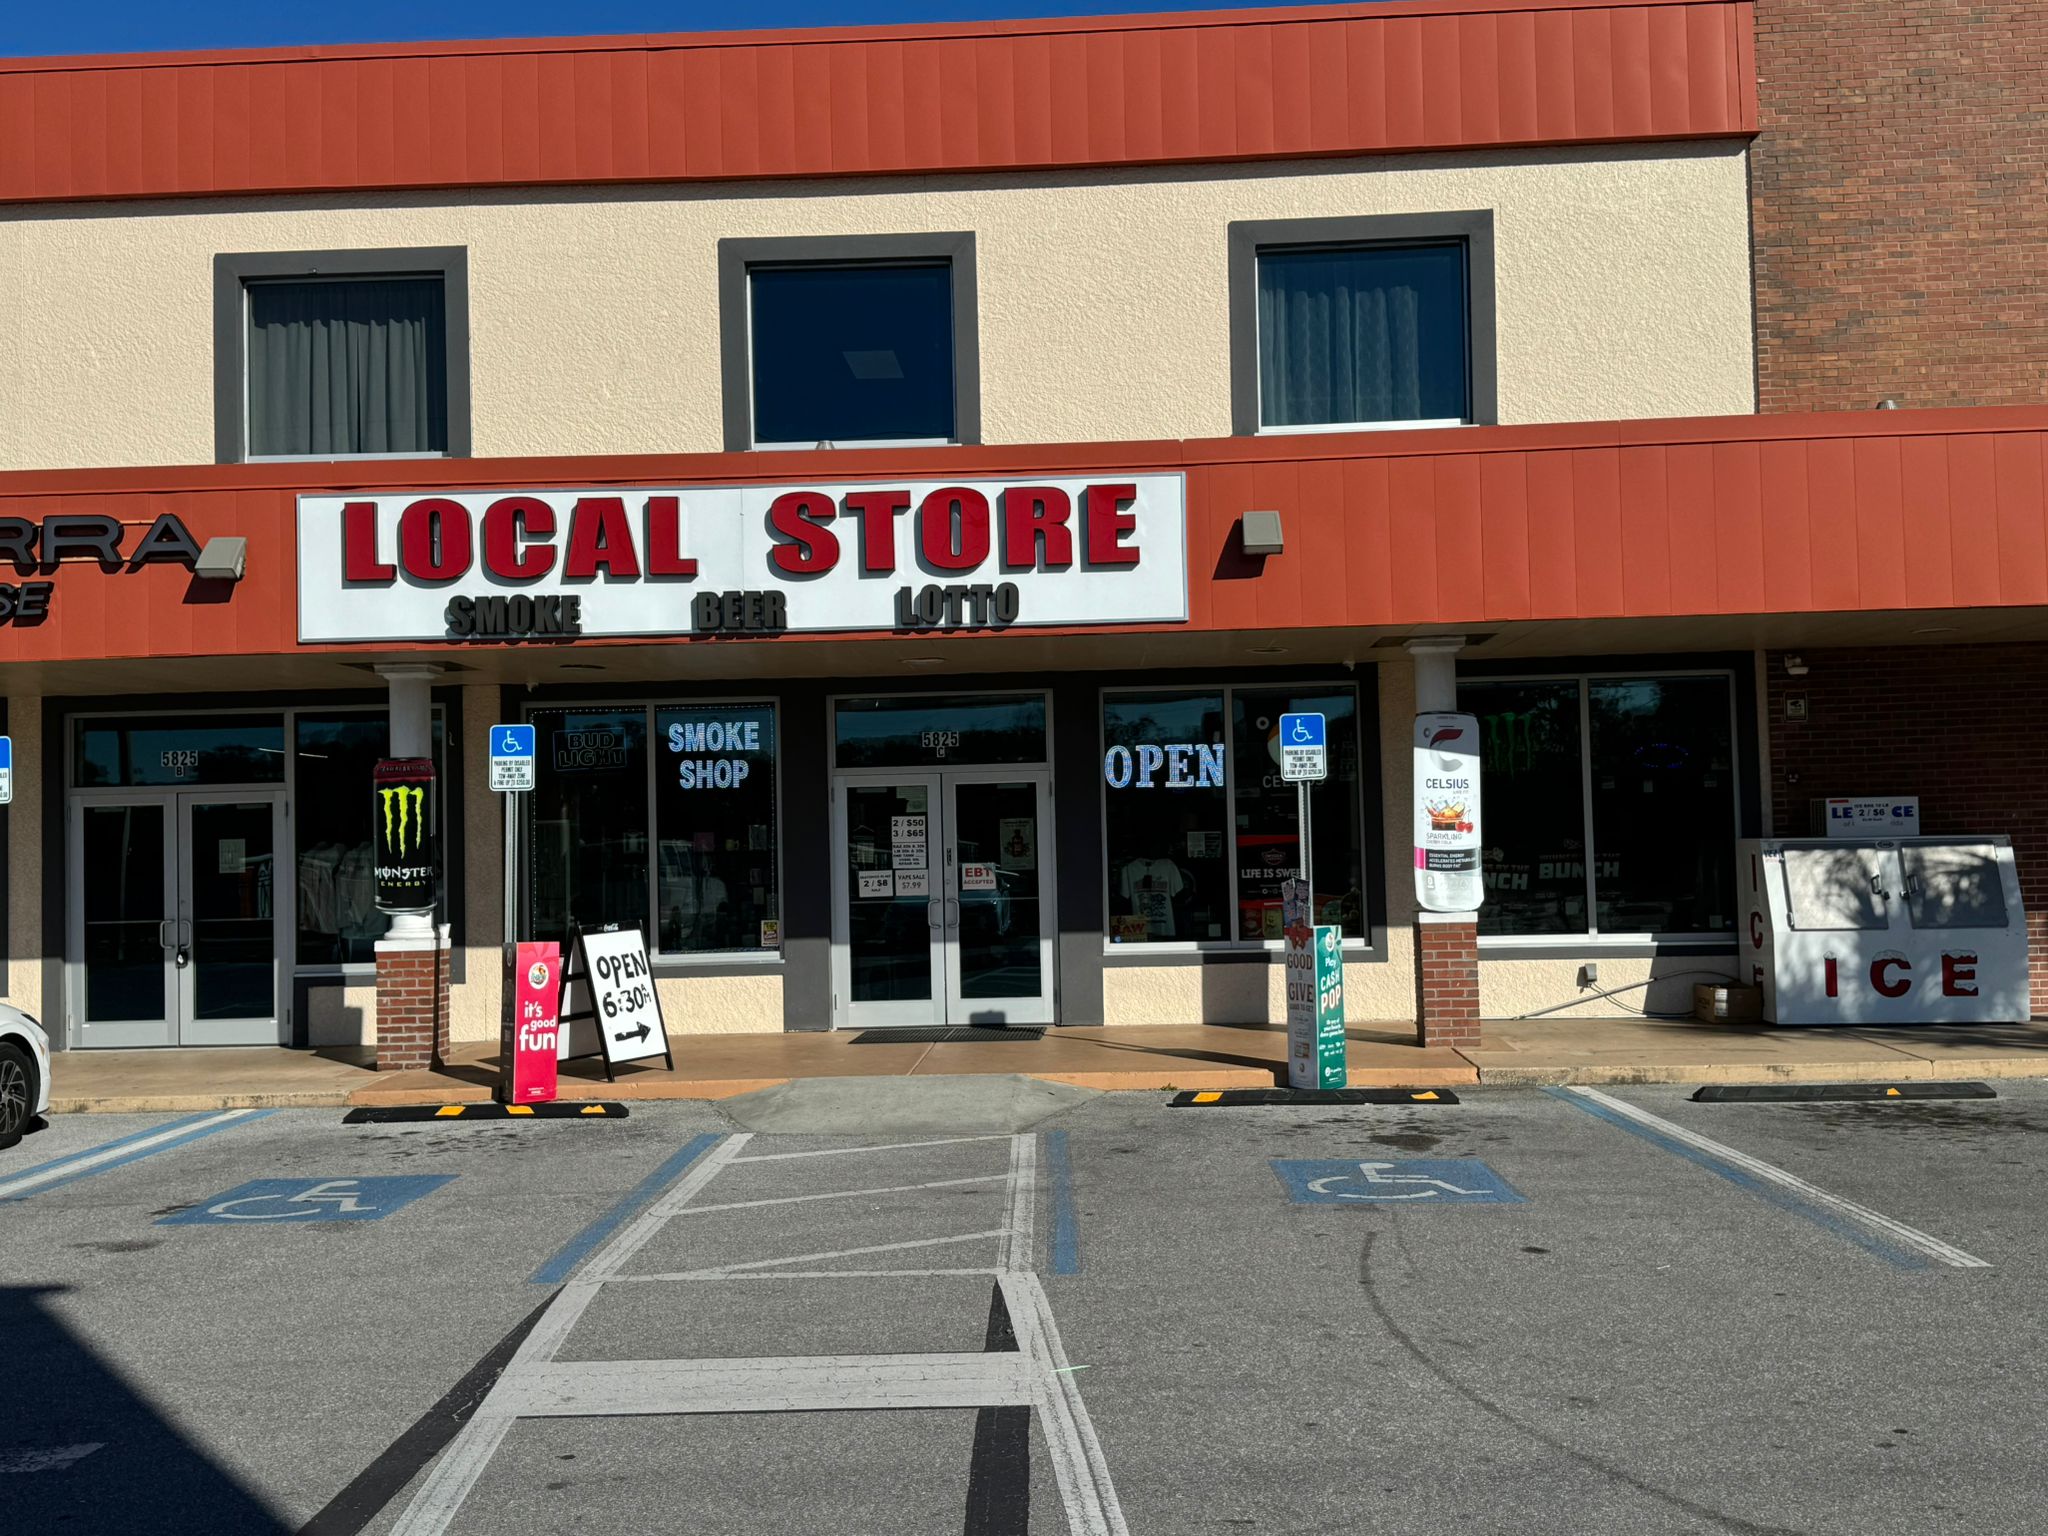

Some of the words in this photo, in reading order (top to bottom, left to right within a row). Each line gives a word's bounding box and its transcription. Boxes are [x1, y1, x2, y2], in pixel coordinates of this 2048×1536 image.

[343, 495, 699, 583] LOCAL
[770, 483, 1141, 574] STORE
[446, 593, 582, 636] SMOKE
[695, 590, 787, 631] BEER
[899, 582, 1020, 625] LOTTO
[567, 731, 615, 750] BUD
[668, 721, 760, 753] SMOKE
[923, 731, 959, 747] 5825
[162, 751, 198, 767] 5825
[558, 747, 625, 768] LIGHT
[1104, 743, 1225, 789] OPEN
[177, 767, 184, 777] B
[679, 759, 749, 789] SHOP
[1425, 778, 1469, 789] CELSIUS
[1891, 805, 1914, 818] CE
[906, 819, 924, 827] $50
[906, 829, 924, 837] $65
[374, 865, 433, 880] MONSTER
[965, 867, 992, 877] EBT
[1241, 868, 1262, 878] LIFE
[1264, 868, 1274, 878] IS
[1275, 868, 1302, 878] SWEE
[1483, 872, 1529, 891] NCH
[596, 950, 648, 988] OPEN
[1287, 953, 1313, 970] GOOD
[1325, 957, 1337, 969] Play
[1321, 969, 1340, 991] CASH
[1823, 949, 1979, 998] ICE
[1288, 982, 1314, 1003] GIVE
[1320, 984, 1341, 1015] POP
[524, 1000, 543, 1019] it's
[602, 987, 644, 1018] 6:30
[530, 1016, 556, 1032] good
[519, 1024, 556, 1052] fun
